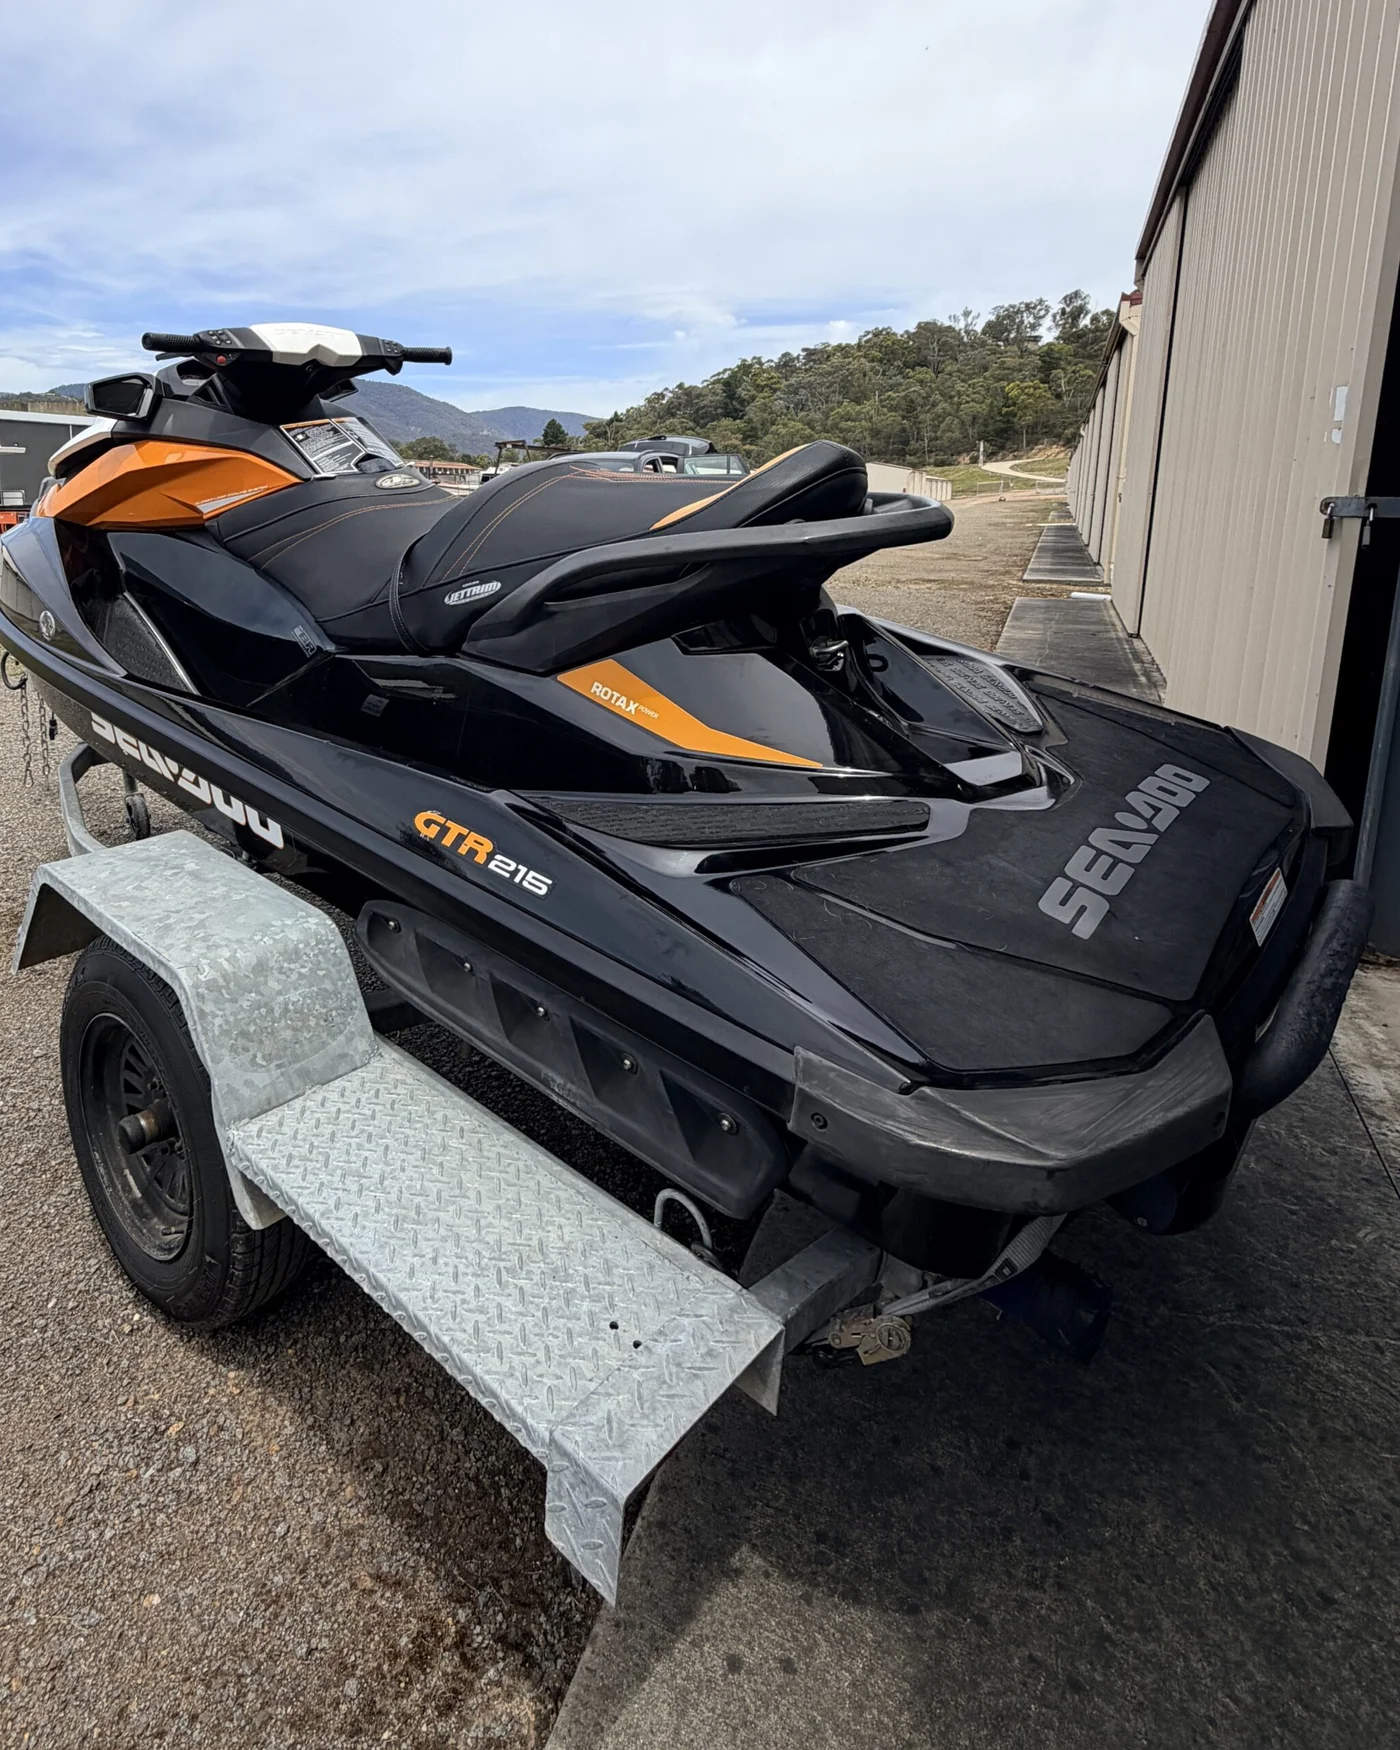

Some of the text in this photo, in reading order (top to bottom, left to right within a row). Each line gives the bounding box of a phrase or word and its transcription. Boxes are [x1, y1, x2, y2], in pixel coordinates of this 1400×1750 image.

[446, 582, 501, 604] JETTRIM
[591, 681, 660, 719] ROTAX POWER
[413, 811, 553, 896] GTR 215
